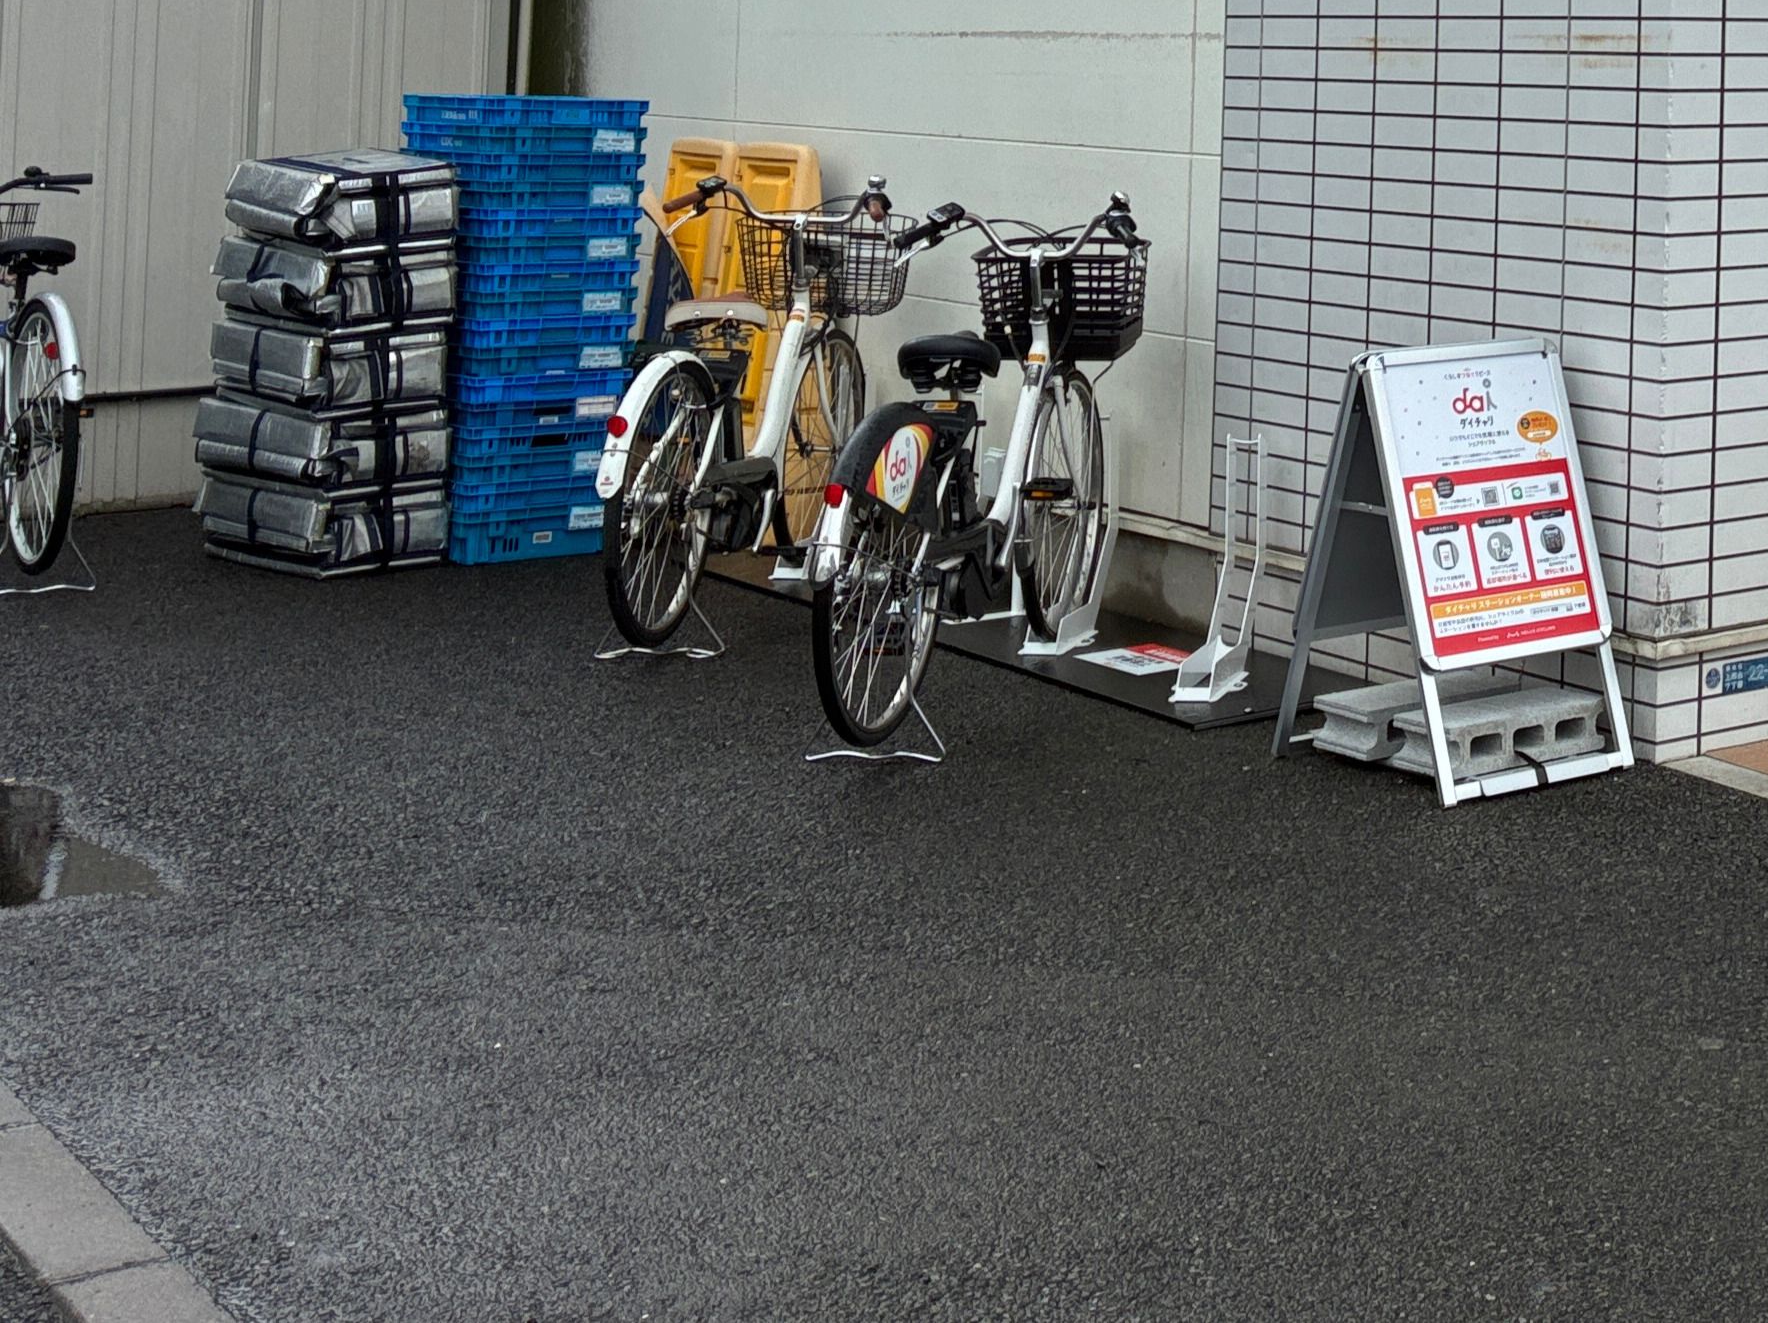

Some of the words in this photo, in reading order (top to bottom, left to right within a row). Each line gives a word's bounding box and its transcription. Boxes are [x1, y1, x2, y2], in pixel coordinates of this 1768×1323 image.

[1452, 378, 1498, 414] dai
[1459, 415, 1494, 430] ダイチャリ
